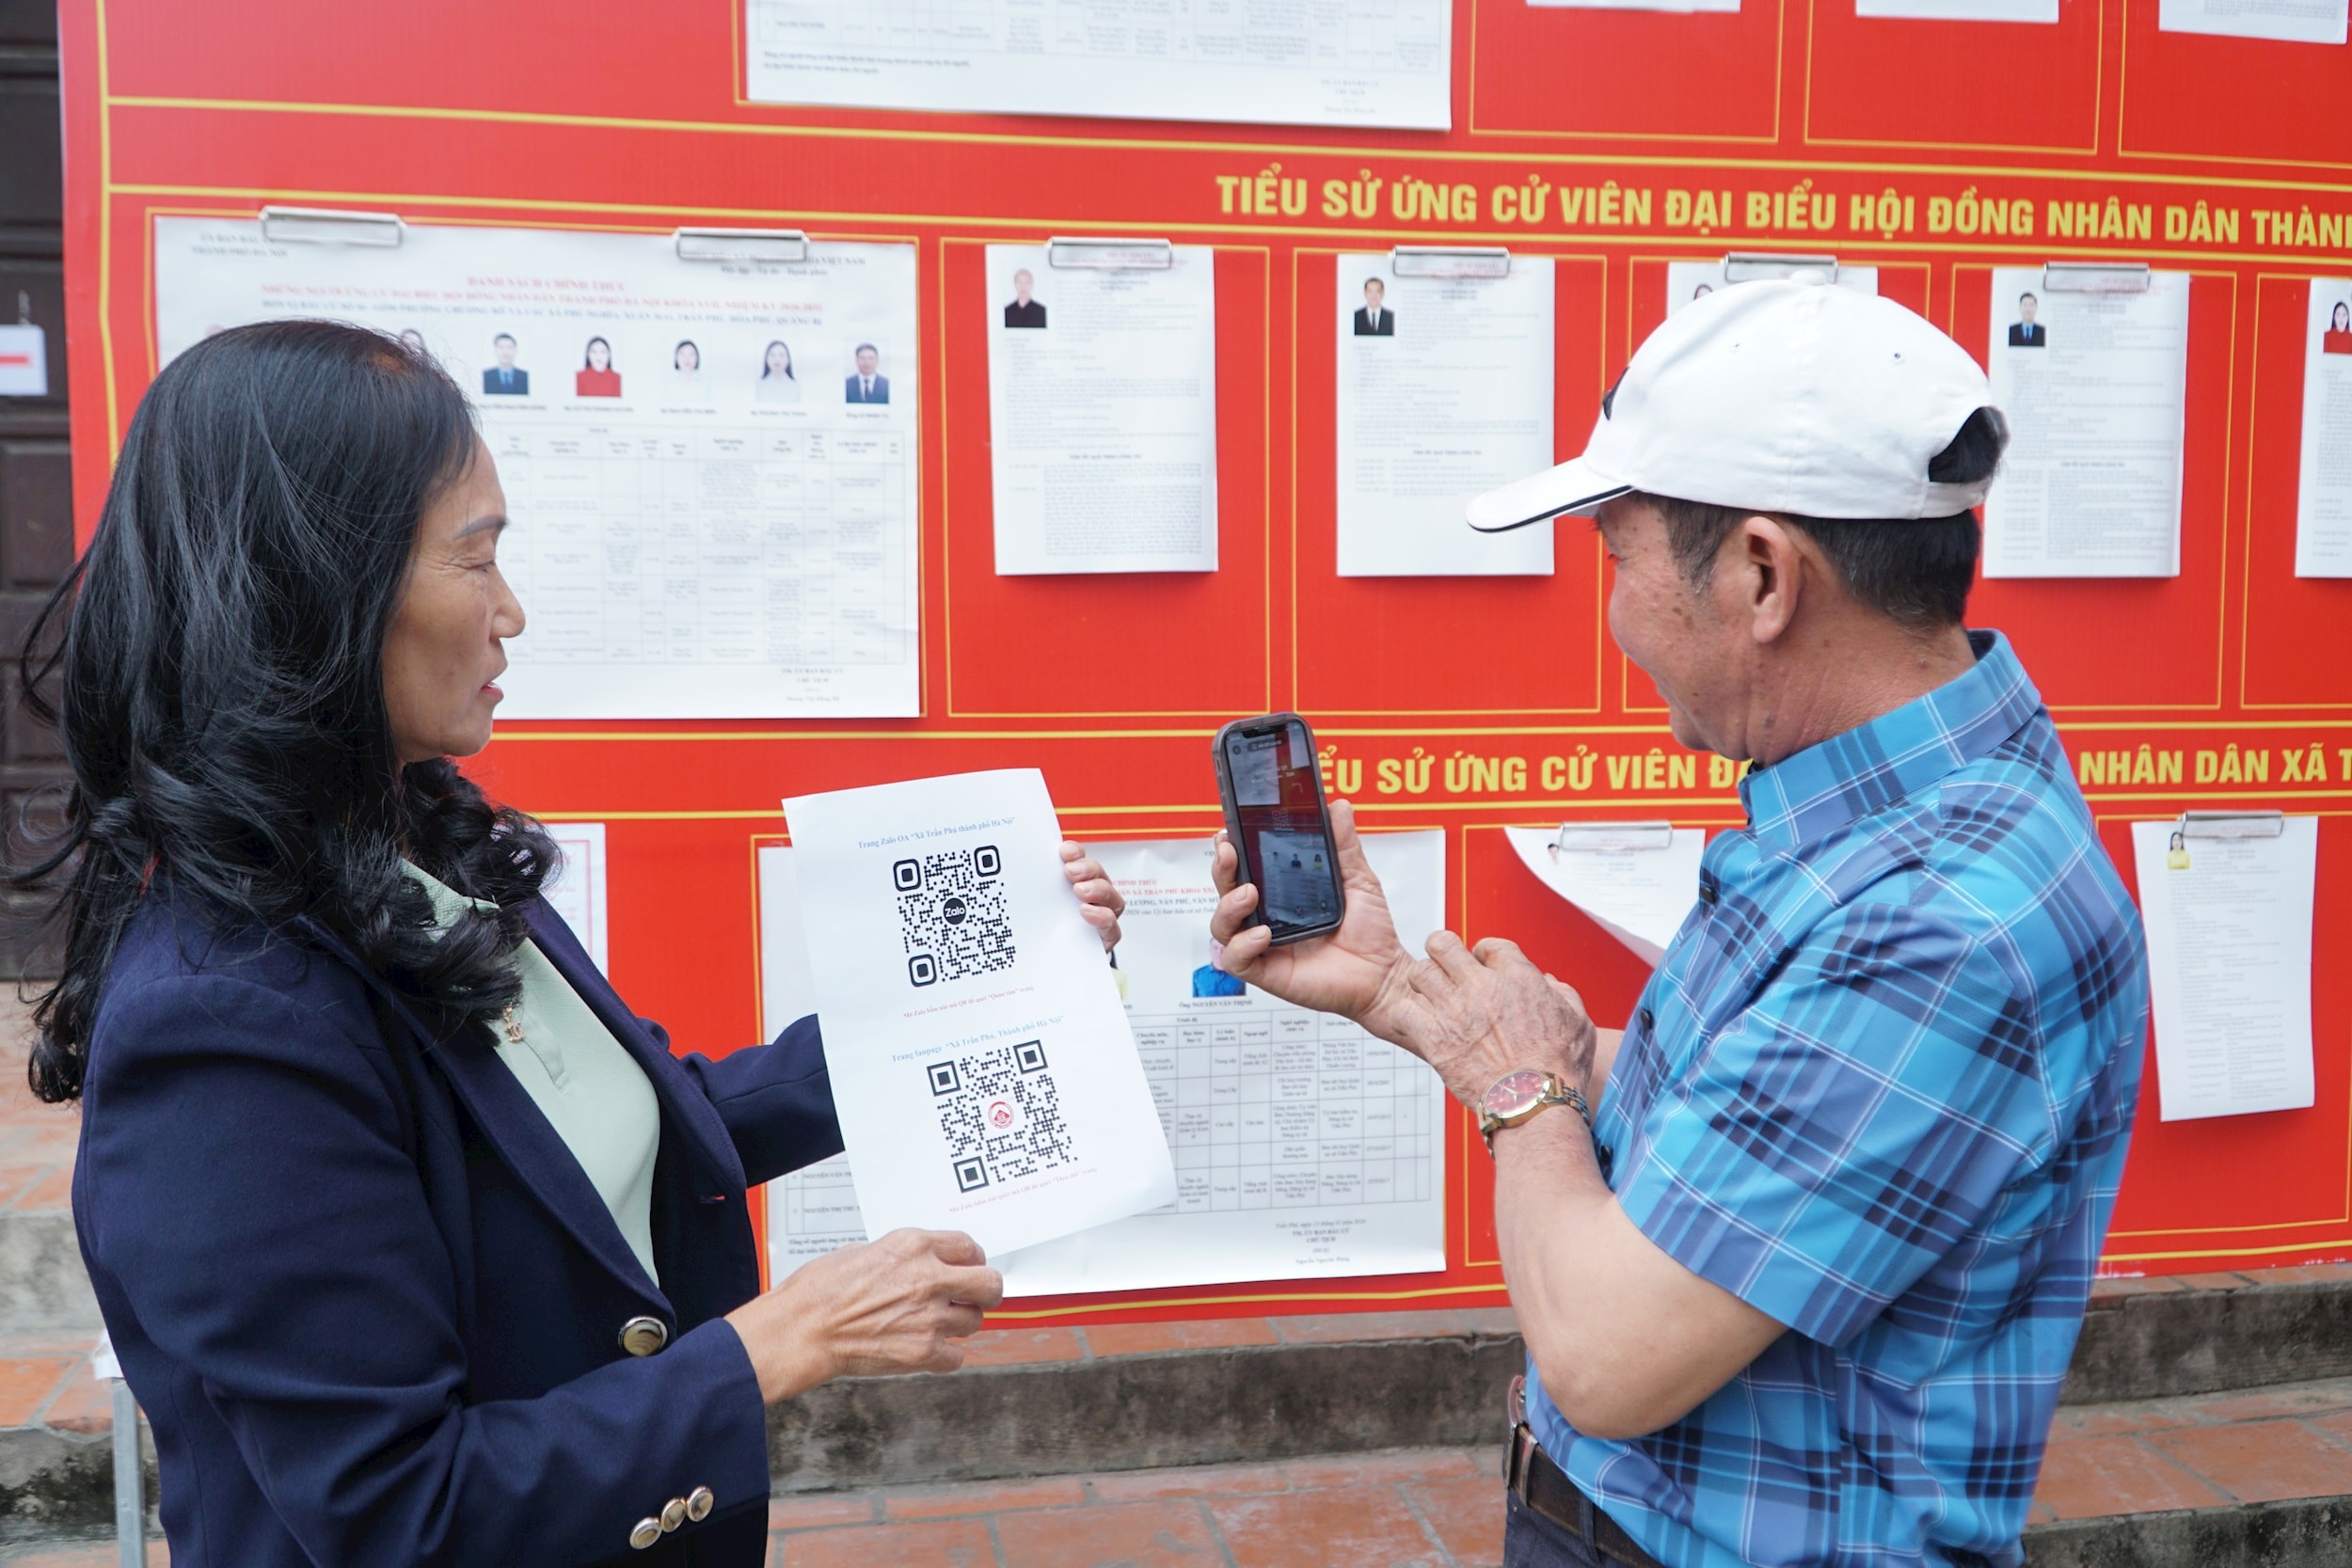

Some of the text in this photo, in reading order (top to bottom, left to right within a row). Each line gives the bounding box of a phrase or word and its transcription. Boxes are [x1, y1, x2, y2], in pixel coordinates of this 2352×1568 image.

[1216, 163, 2352, 248] TIỂU SỬ ỨNG CỬ VIÊN ĐẠI BIỂU HỘI ĐỒNG NHÂN DÂN THÀN
[1318, 744, 1362, 794] ỂU
[1376, 747, 1435, 793] SỬ
[1445, 750, 1526, 792] ỨNG
[1541, 744, 1597, 791] CỬ
[1607, 748, 1695, 789] VIÊN
[2080, 743, 2183, 784] NHÂN
[2195, 742, 2268, 783] DÂN
[2280, 742, 2328, 783] XÃ
[858, 840, 880, 849] Trang
[881, 836, 897, 846] Zalo
[897, 833, 910, 843] OA
[926, 827, 943, 837] Trần
[959, 822, 977, 832] thành
[978, 820, 991, 832] phố
[992, 819, 1001, 828] Hà
[945, 906, 965, 918] Zalo
[892, 1053, 914, 1063] Trang
[914, 1046, 942, 1059] fanpage
[961, 1036, 979, 1047] Trần
[998, 1027, 1021, 1038] Thành
[1022, 1022, 1036, 1034] phố
